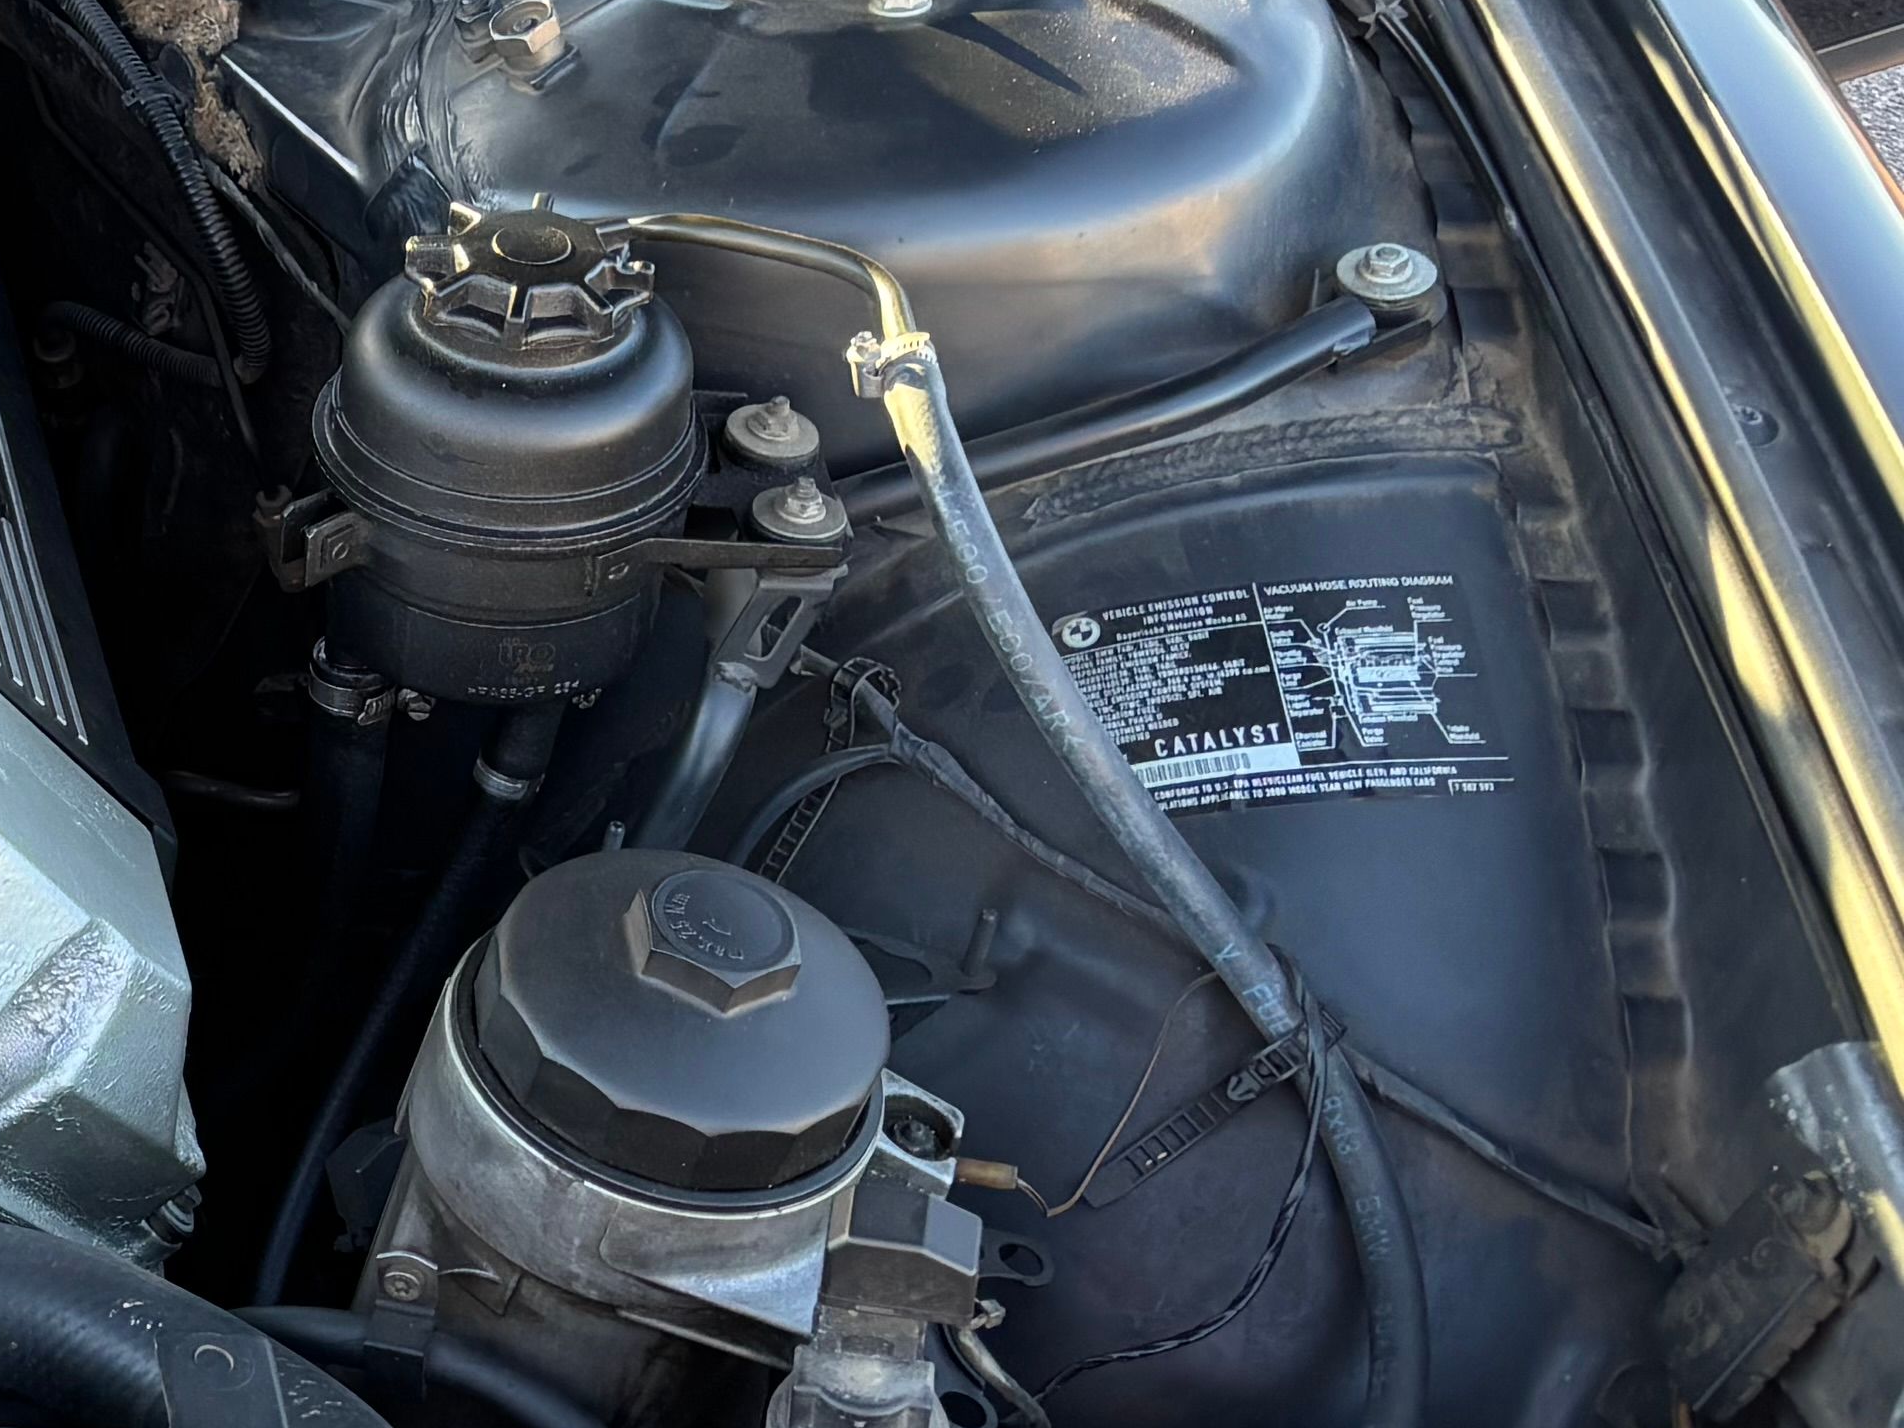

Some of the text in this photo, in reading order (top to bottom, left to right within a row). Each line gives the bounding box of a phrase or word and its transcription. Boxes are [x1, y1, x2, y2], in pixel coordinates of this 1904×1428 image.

[1264, 575, 1453, 596] VACUUM HOSE ROUTING DIAGRAM
[1147, 595, 1199, 613] EMISSION
[1202, 588, 1250, 605] CONTROL
[1142, 606, 1214, 626] INFORMATION
[1154, 723, 1280, 758] CATALYST
